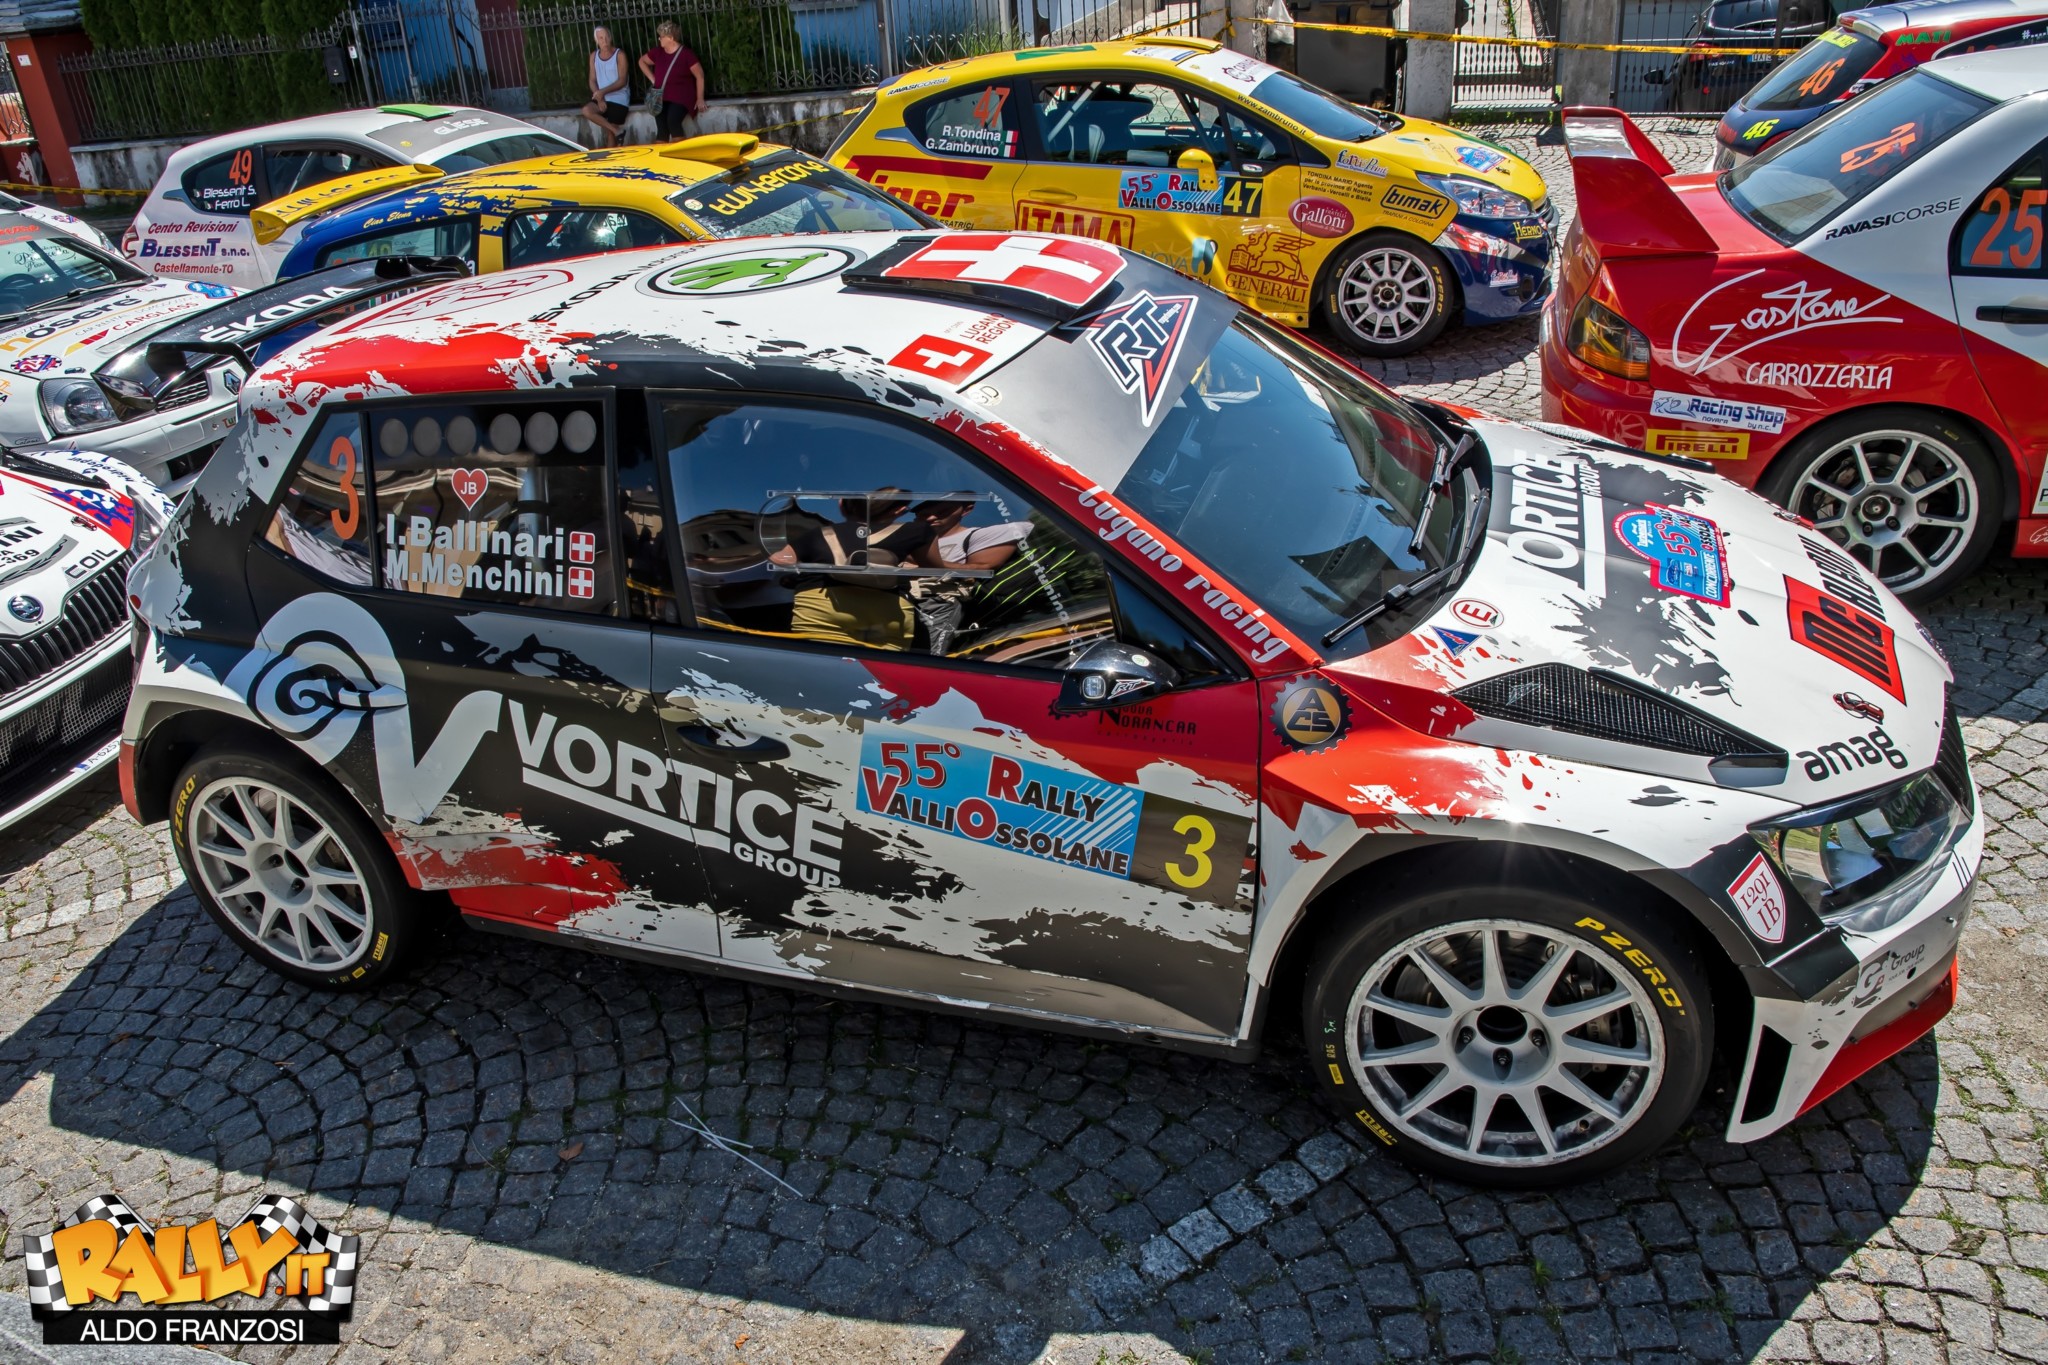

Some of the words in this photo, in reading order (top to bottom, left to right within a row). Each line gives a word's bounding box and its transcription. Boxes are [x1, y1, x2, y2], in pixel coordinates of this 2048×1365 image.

[887, 76, 950, 97] RAVASICORSE
[1799, 58, 1845, 97] 46
[973, 86, 1011, 128] 47
[1236, 94, 1307, 137] www.zambruno.it
[942, 125, 1001, 142] R.Tondina
[1743, 118, 1780, 141] 46
[925, 138, 999, 156] G.Zambruno
[229, 150, 253, 185] 49
[1307, 171, 1333, 180] TONDINA
[1334, 175, 1353, 185] MARIO
[1353, 181, 1374, 190] Agente
[203, 186, 246, 199] Blessent
[215, 199, 240, 210] Ferro
[1223, 183, 1262, 214] 47
[1385, 188, 1443, 216] bimak
[147, 222, 183, 234] Centro
[184, 221, 240, 234] Revisioni
[1293, 203, 1346, 230] Galloni
[1825, 197, 1962, 240] RAVASICORSE
[1969, 187, 2046, 268] 25
[221, 248, 250, 257] s.n.c.
[154, 262, 234, 274] Castellamonte-TO
[1225, 273, 1308, 303] GENERALI
[199, 285, 365, 344] ŠKODA
[960, 312, 1004, 340] LUGANO
[1746, 362, 1893, 390] CARROZZERIA
[1690, 398, 1743, 422] Racing
[1745, 406, 1785, 427] Shop
[1656, 434, 1740, 454] PIRELLI
[329, 436, 360, 540] 3
[460, 481, 478, 495] JB
[386, 513, 564, 560] I.Ballinari
[65, 549, 118, 579] COIL
[386, 548, 564, 598] M.Menchini
[1183, 574, 1291, 664] racing
[1460, 602, 1493, 622] E
[1795, 726, 1909, 782] amag
[509, 699, 846, 873] VORTICE
[880, 740, 962, 788] 55°
[987, 754, 1105, 823] RALLY
[733, 842, 842, 890] GROUP
[1165, 814, 1217, 889] 3
